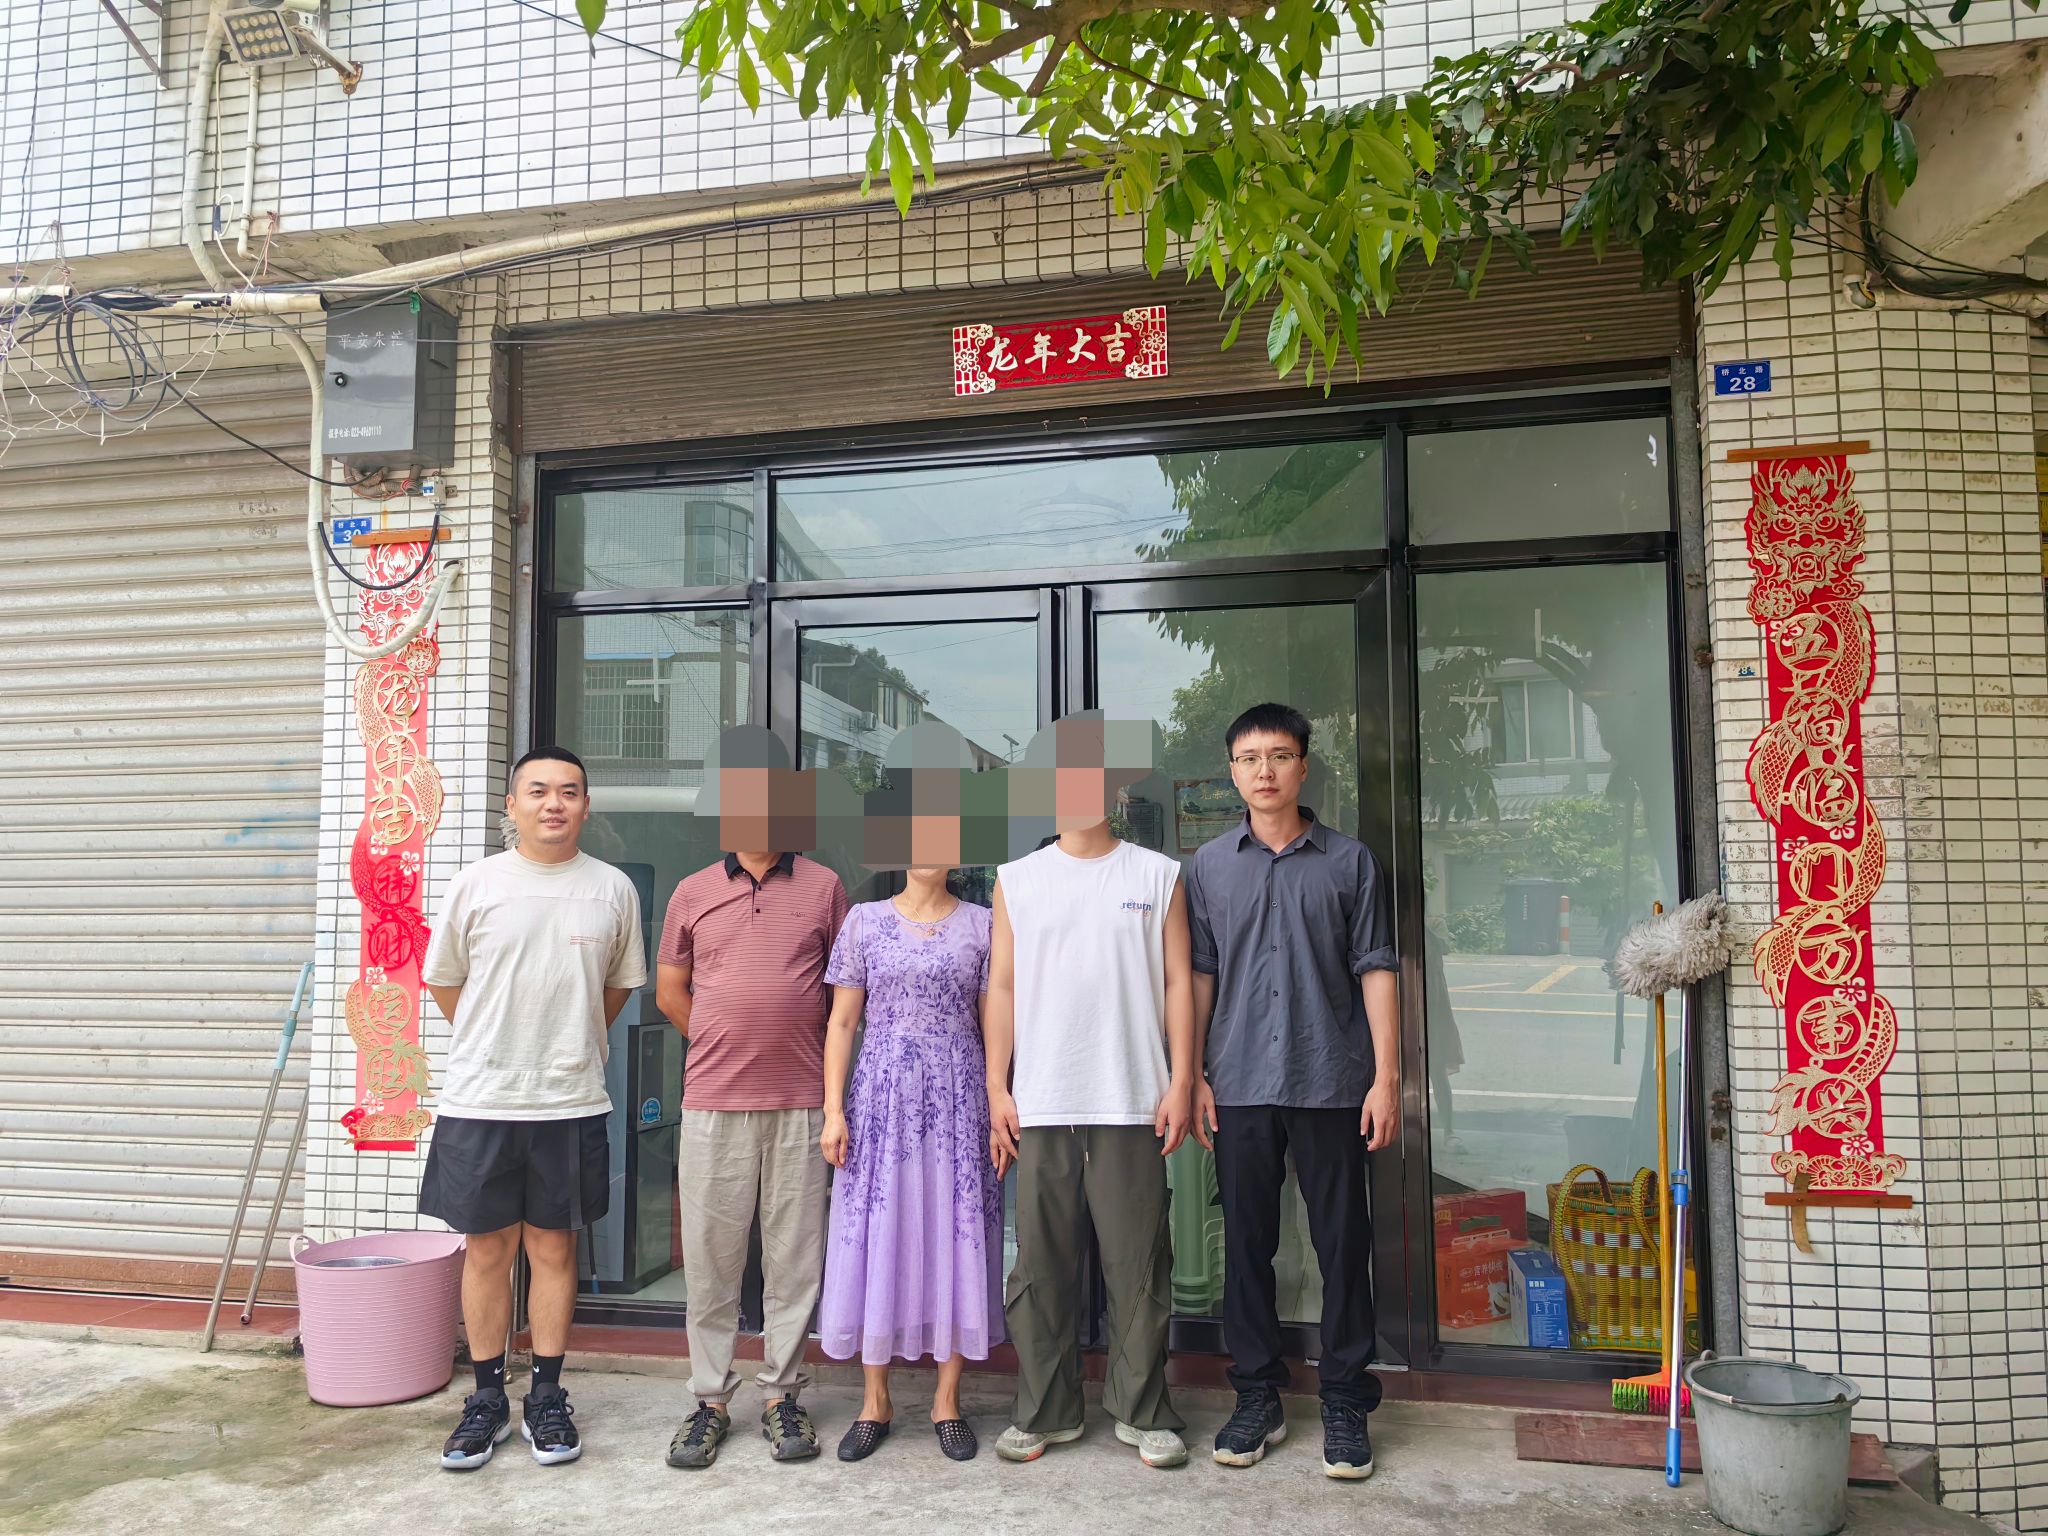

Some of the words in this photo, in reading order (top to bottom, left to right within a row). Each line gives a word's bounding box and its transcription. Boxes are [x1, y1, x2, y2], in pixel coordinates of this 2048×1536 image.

[986, 321, 1132, 374] 龙年大吉
[1721, 365, 1764, 376] 桥北路
[1729, 376, 1756, 392] 28
[366, 672, 418, 1097] 龙年吉祥财运旺
[1780, 613, 1870, 1136] 五福临门万事兴
[1121, 901, 1152, 911] return
